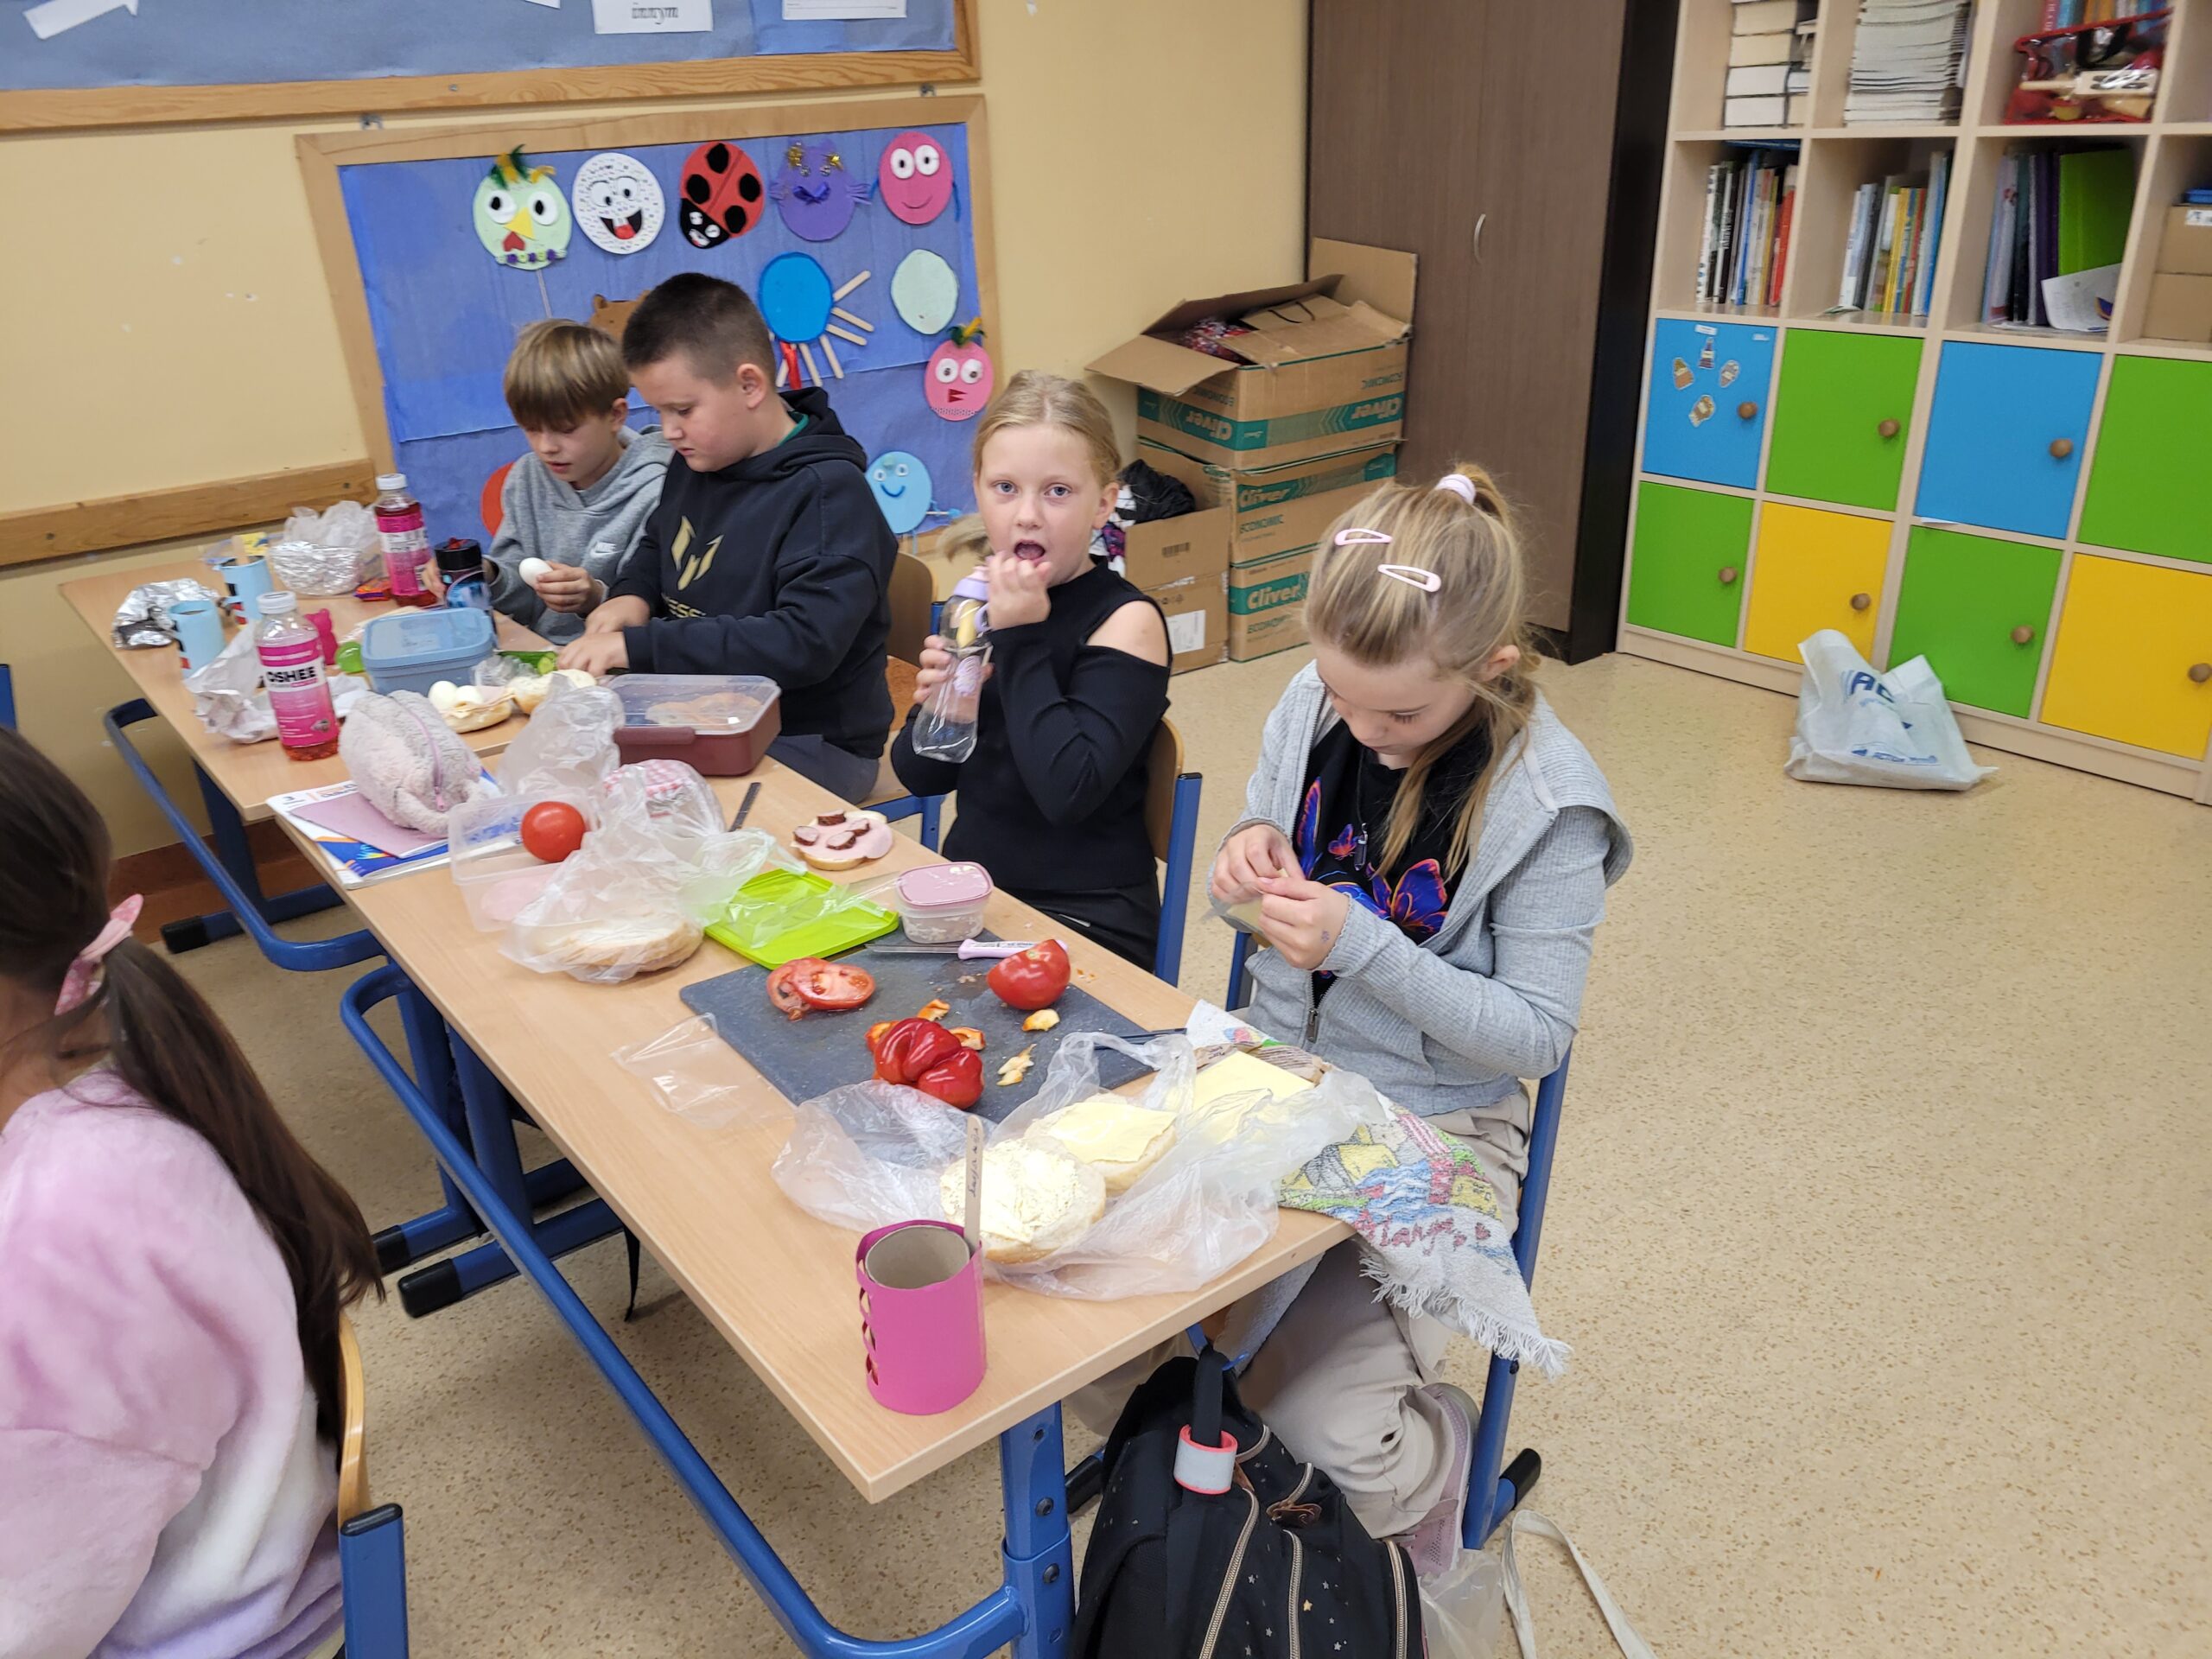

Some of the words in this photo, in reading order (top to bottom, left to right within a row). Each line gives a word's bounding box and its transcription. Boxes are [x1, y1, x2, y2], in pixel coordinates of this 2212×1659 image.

[1351, 397, 1402, 420] Cliver
[1185, 410, 1232, 441] Cliver
[1240, 487, 1292, 509] Cliver
[1240, 514, 1285, 534] ECONOMIC
[1247, 585, 1302, 609] Cliver
[266, 665, 318, 683] OSHEE
